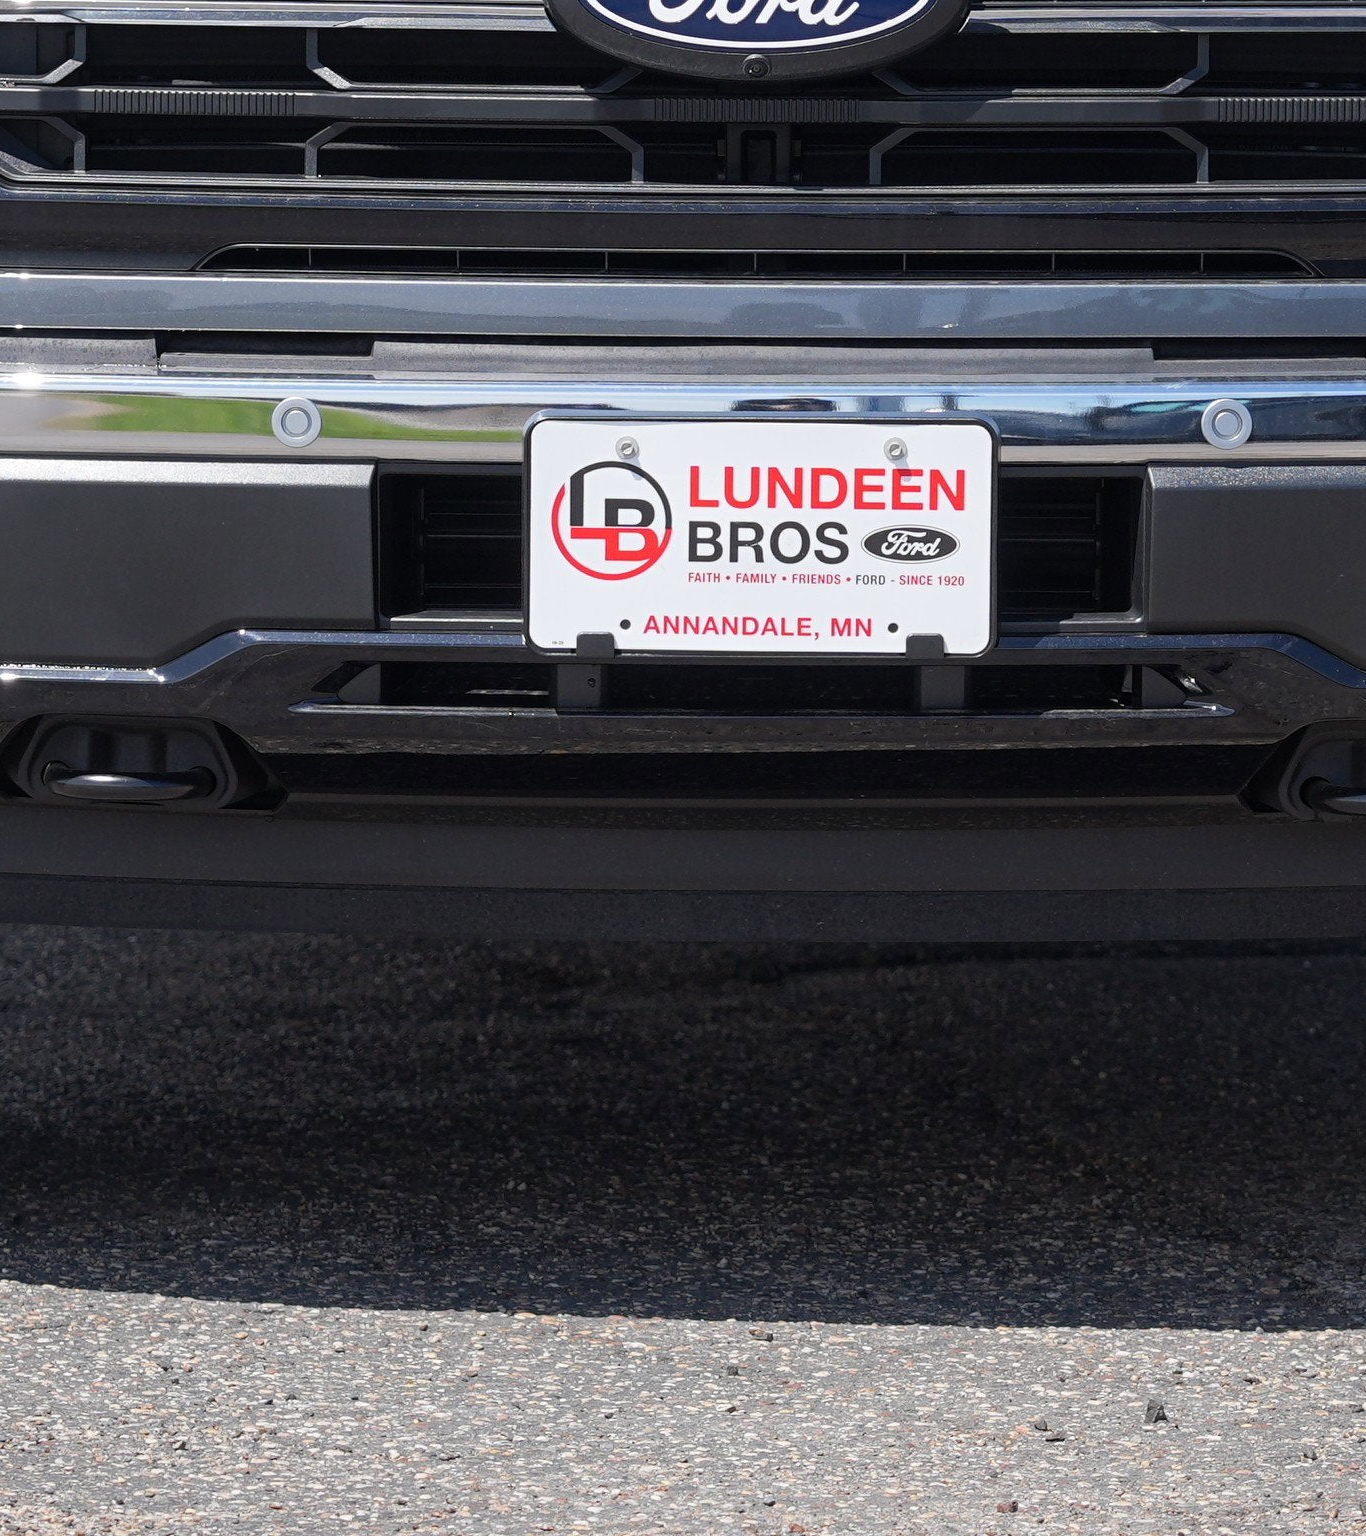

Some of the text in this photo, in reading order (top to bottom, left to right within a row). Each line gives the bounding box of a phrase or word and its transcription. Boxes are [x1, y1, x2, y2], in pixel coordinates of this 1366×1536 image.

[688, 465, 966, 511] LUNDEEN
[688, 521, 850, 564] BROS
[880, 529, 941, 557] Ford
[688, 572, 965, 586] FAITH FAMILY FRIENDS FORD SINCE 1920
[643, 615, 873, 640] ANNANDALE, MN
